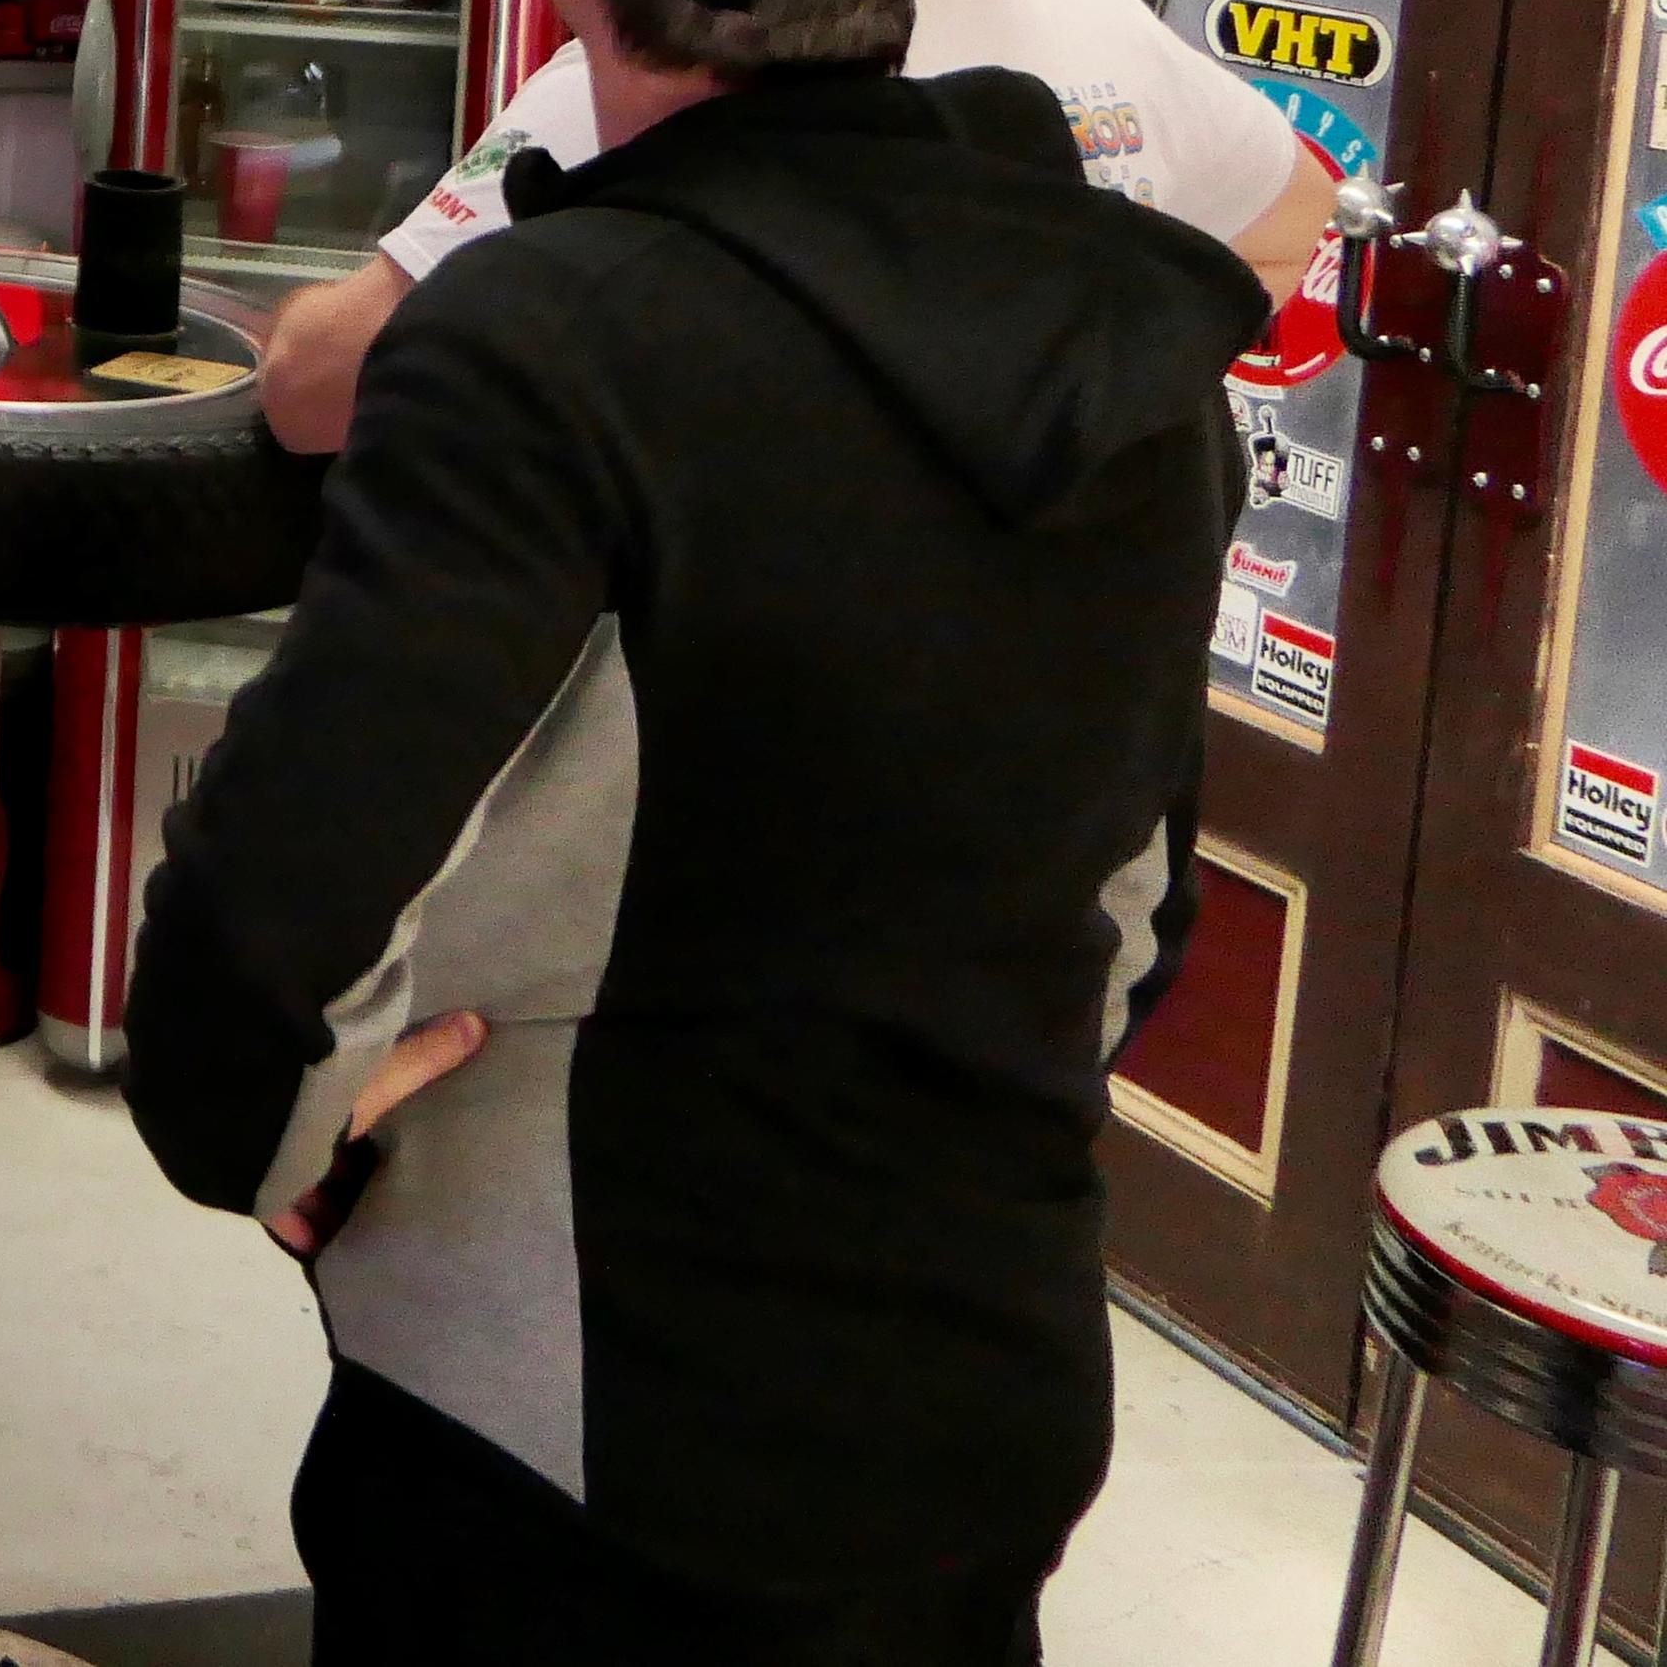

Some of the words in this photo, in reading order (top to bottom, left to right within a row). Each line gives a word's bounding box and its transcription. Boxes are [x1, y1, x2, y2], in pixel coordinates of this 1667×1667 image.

[1228, 1, 1370, 78] VHT
[1290, 451, 1336, 493] TUFF
[1259, 636, 1330, 691] Holley
[1257, 671, 1327, 712] EQUIPPED
[1567, 764, 1653, 831] Holley
[1565, 808, 1647, 855] EQUIPPED
[1414, 1117, 1598, 1168] JIM
